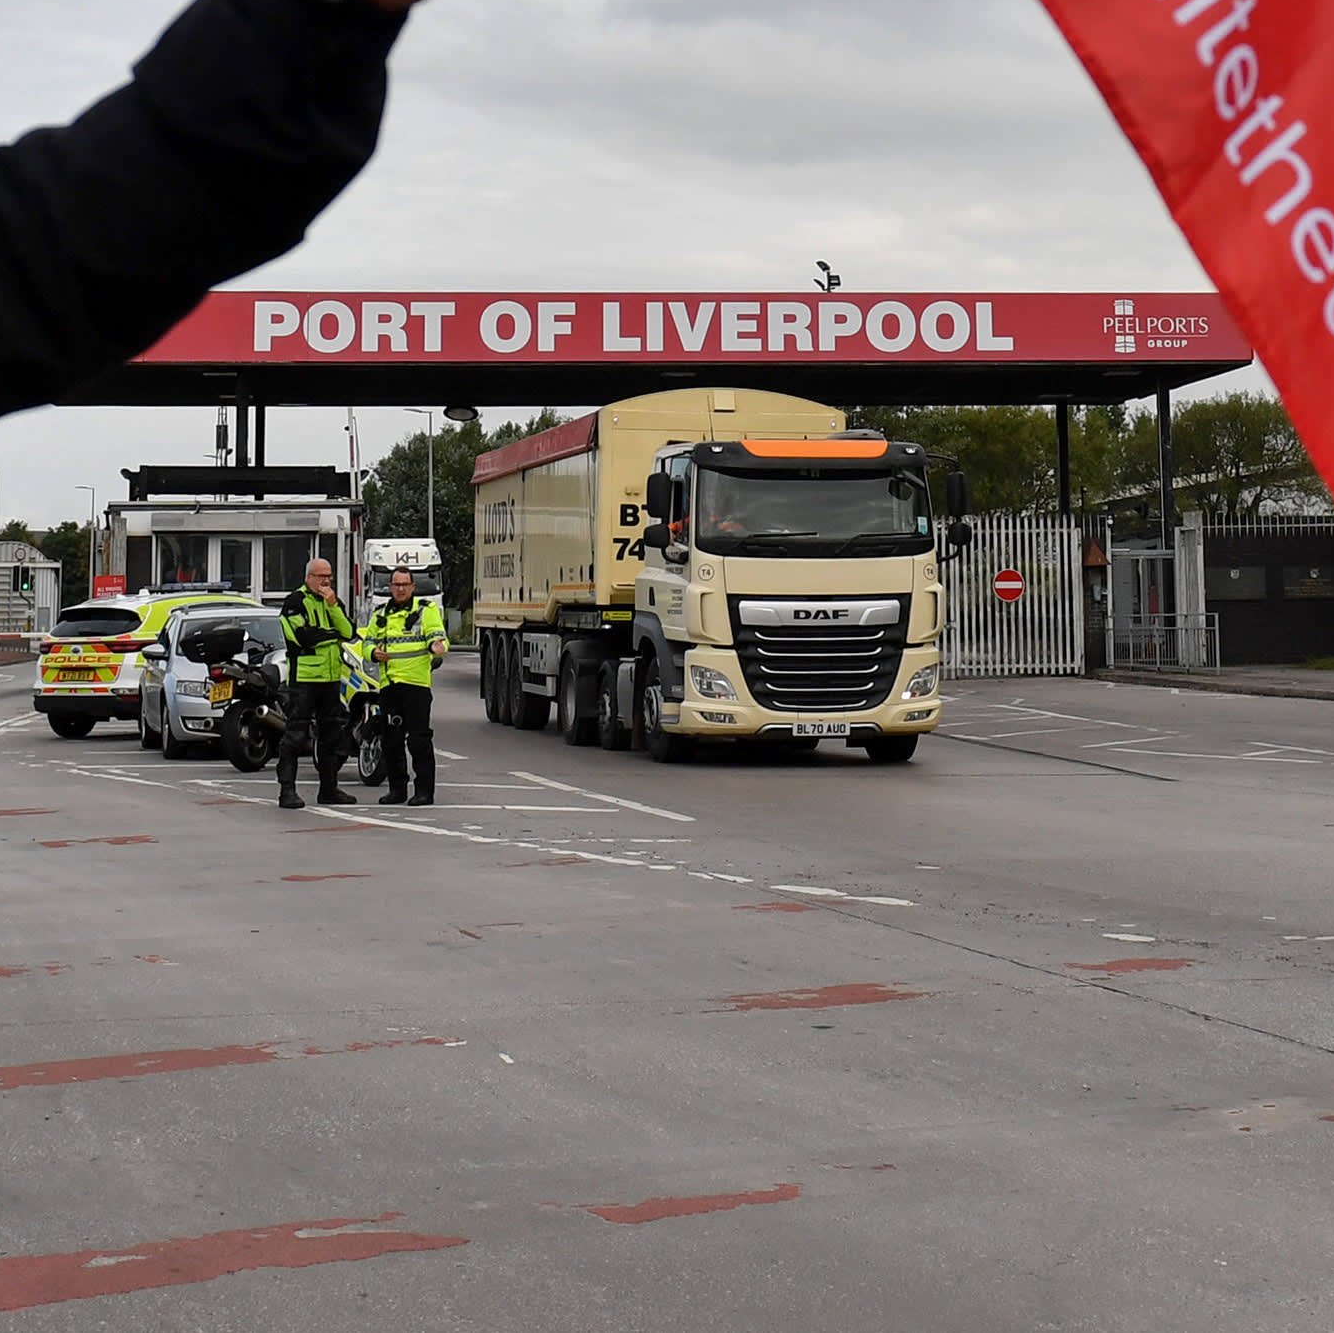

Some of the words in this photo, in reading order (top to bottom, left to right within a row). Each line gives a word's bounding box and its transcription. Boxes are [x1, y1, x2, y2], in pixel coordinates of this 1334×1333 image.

[253, 300, 456, 353] PORT
[479, 300, 576, 353] OF
[602, 300, 1014, 353] LIVERPOOL
[1147, 339, 1188, 348] GROUP
[483, 492, 516, 545] LLOYD'S
[395, 552, 419, 564] KH
[793, 609, 849, 620] DAF
[44, 655, 111, 664] POLICE
[796, 723, 824, 734] BL70
